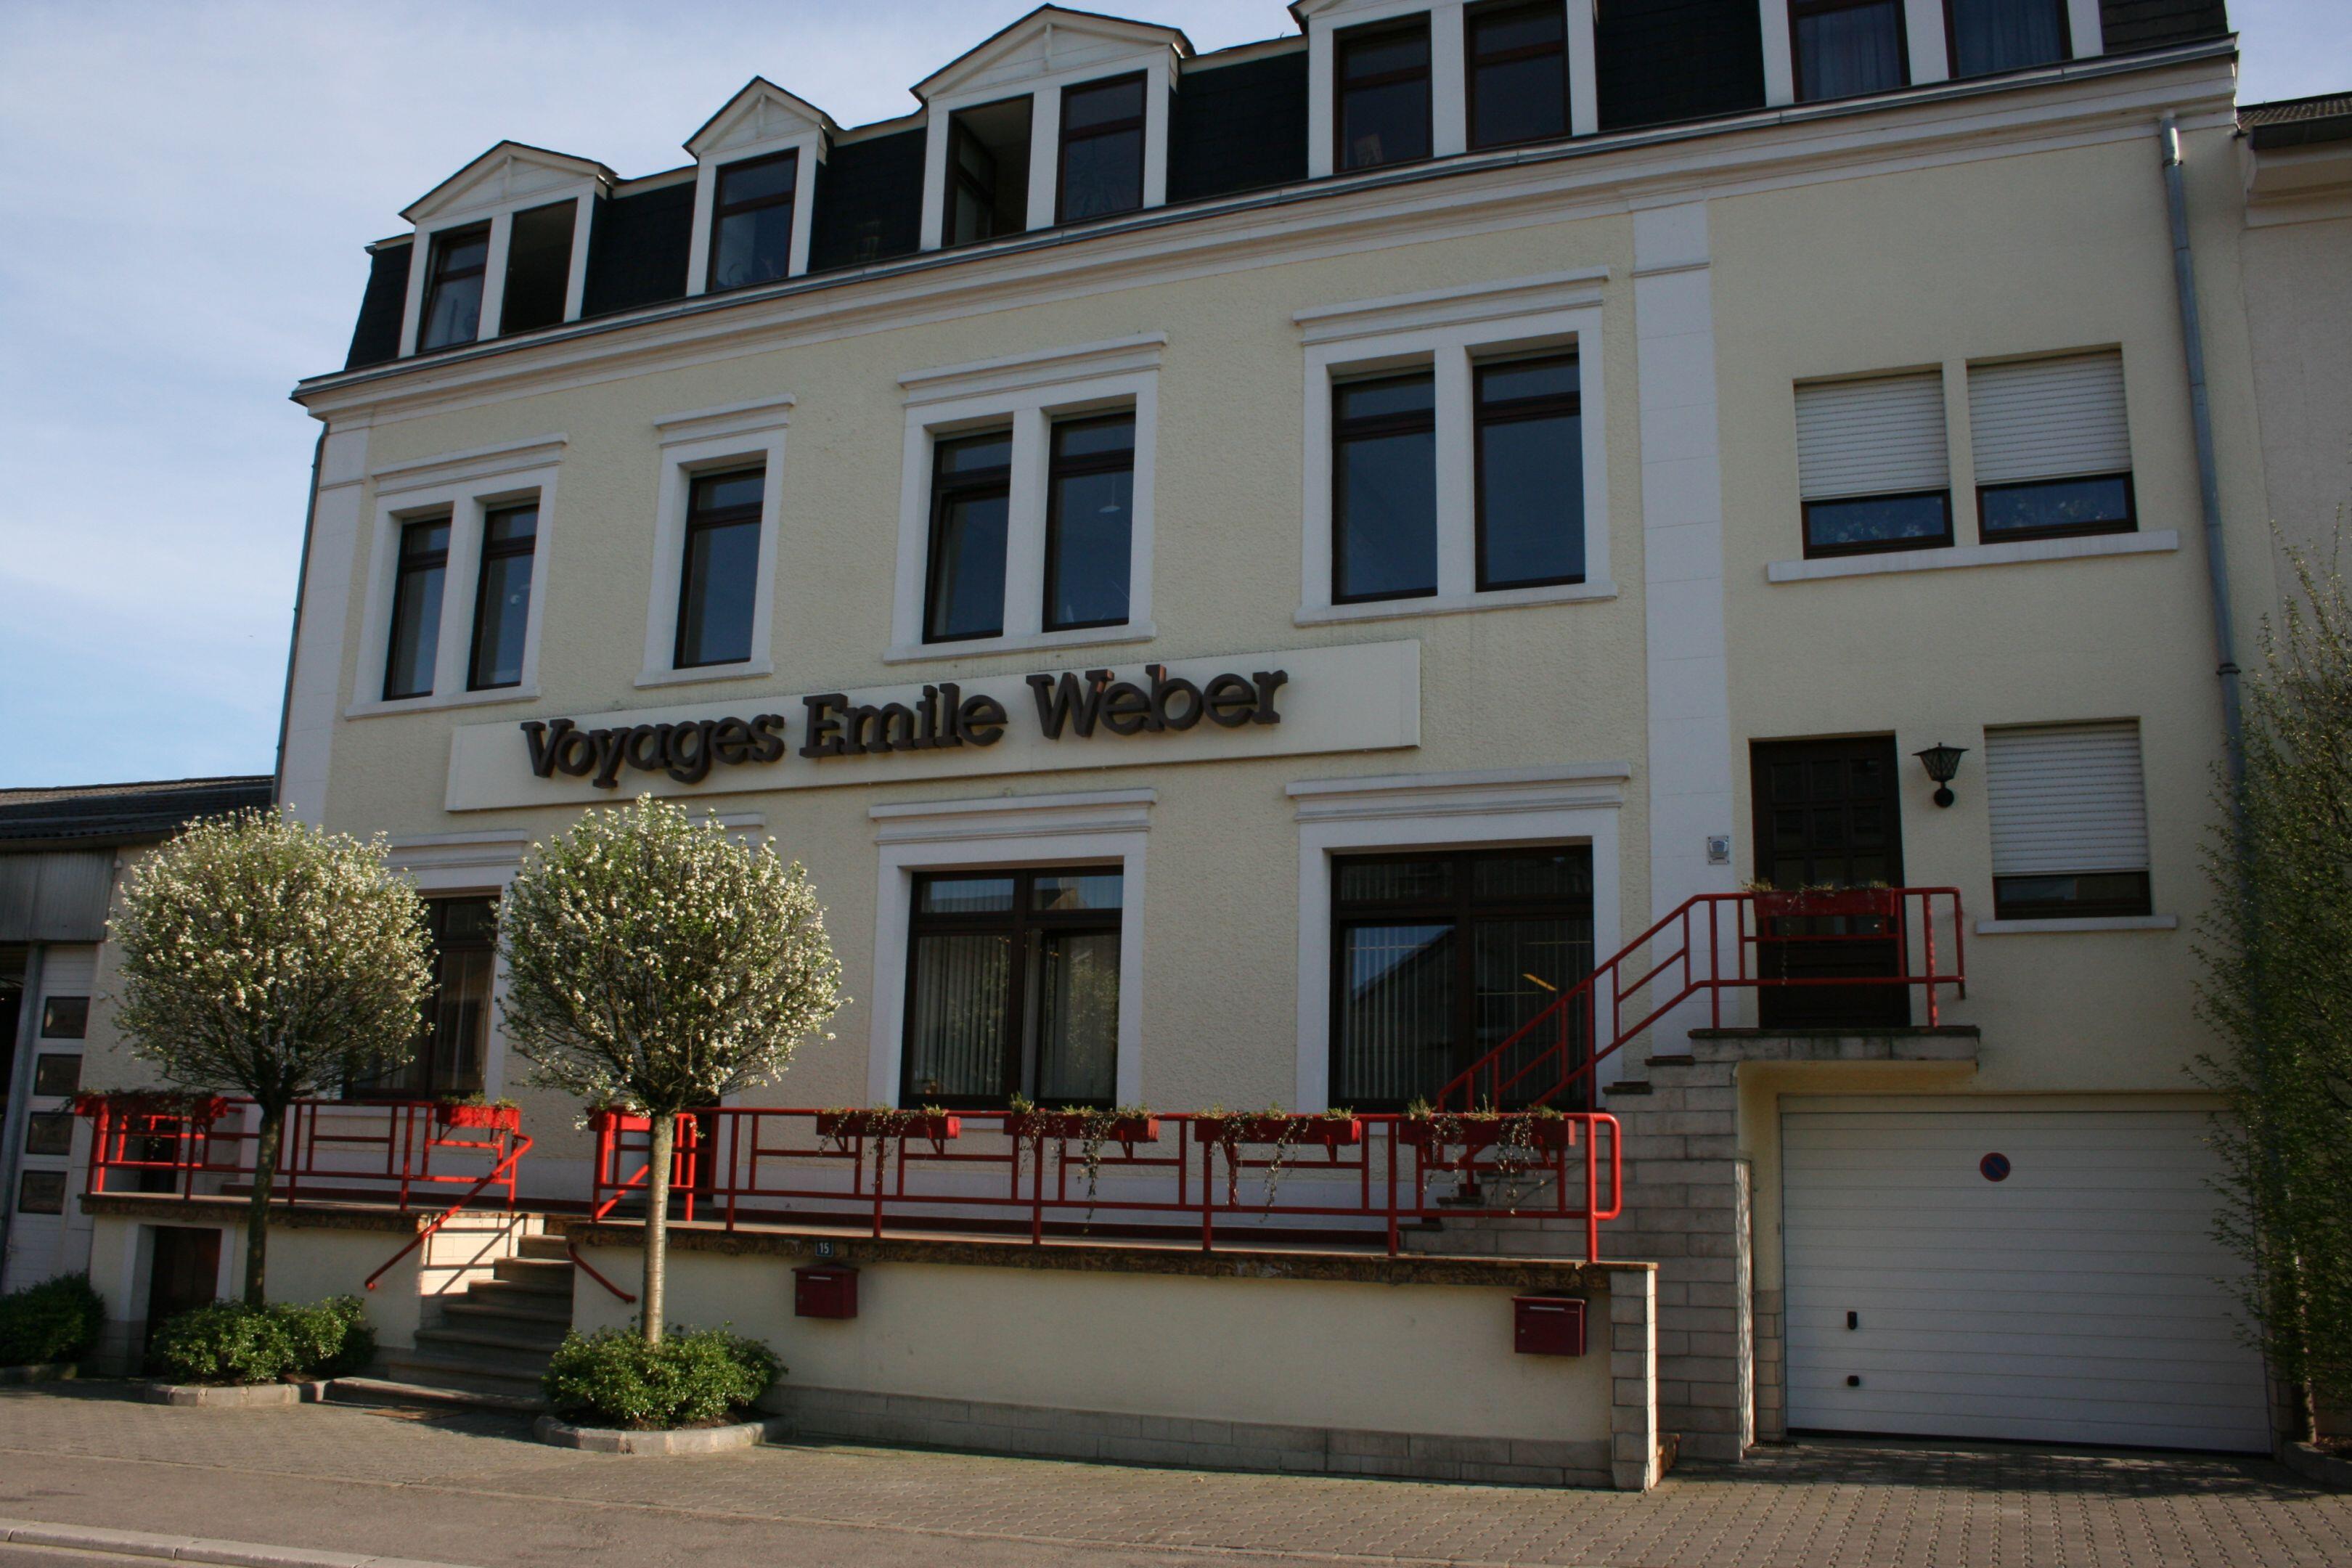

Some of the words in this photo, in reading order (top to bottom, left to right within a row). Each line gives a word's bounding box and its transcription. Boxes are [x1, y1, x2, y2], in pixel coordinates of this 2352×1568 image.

[520, 714, 785, 788] Voyages
[799, 682, 1008, 759] Emile
[1026, 664, 1289, 739] Weber
[819, 1241, 830, 1254] 15
